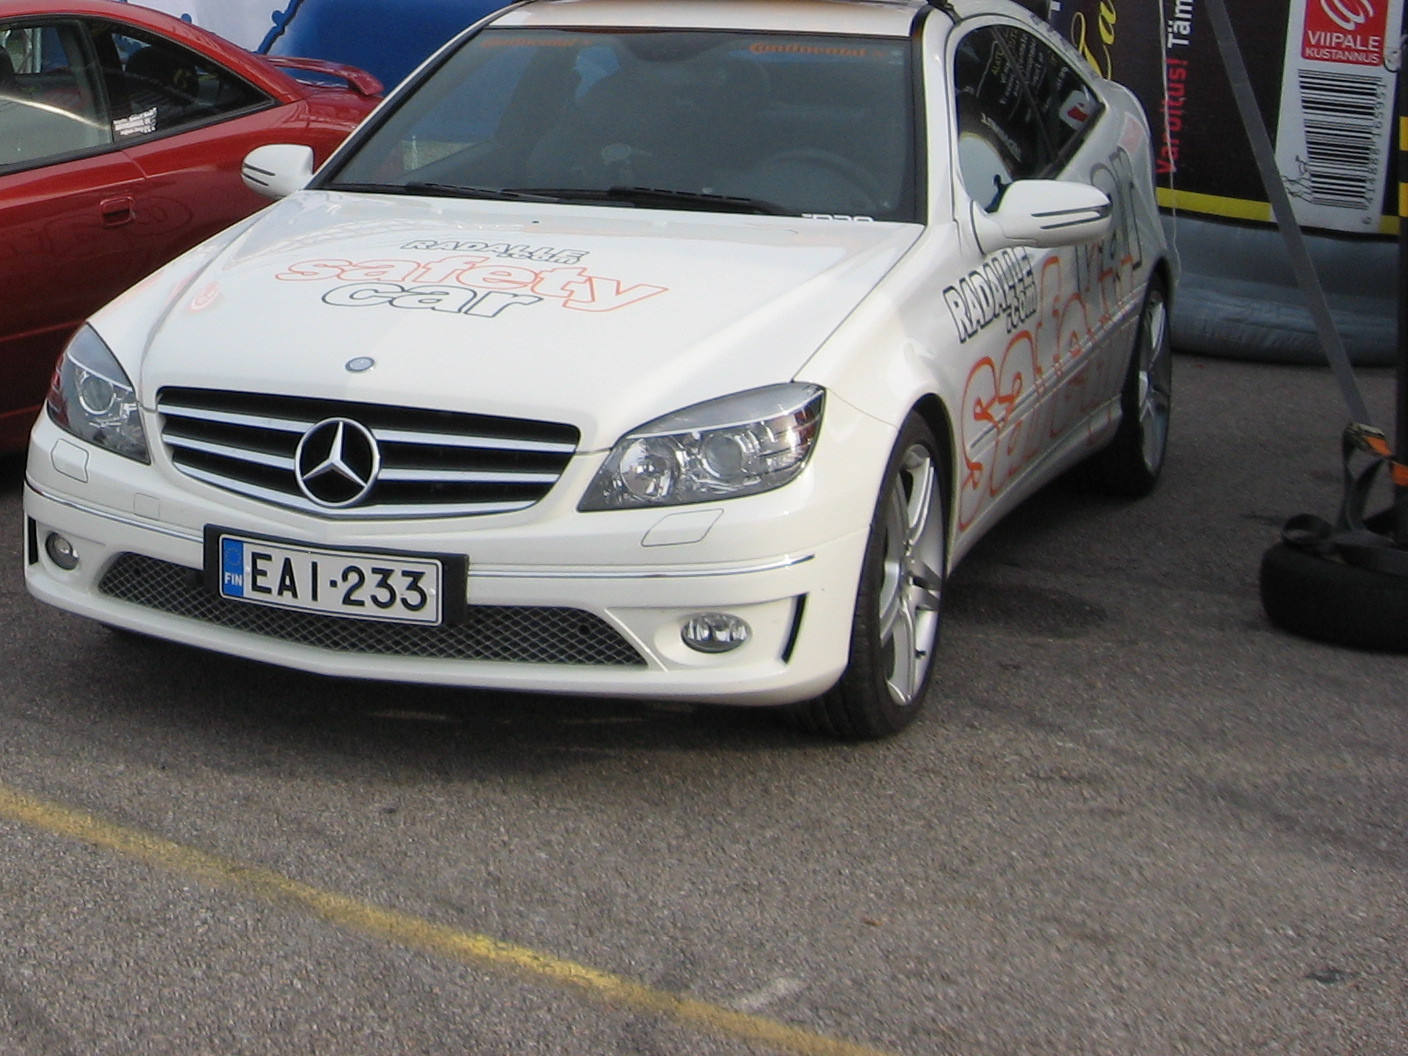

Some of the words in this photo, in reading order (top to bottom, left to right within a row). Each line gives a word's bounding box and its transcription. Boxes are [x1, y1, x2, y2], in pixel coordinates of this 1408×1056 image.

[1304, 46, 1381, 65] KUSTANNUS
[1306, 29, 1382, 53] VIIPALE
[1156, 57, 1189, 175] Varoitus!
[399, 239, 591, 261] RADALLE
[274, 255, 670, 314] safety
[320, 281, 545, 319] car
[224, 573, 243, 587] FIN
[250, 550, 429, 612] EAI-233
